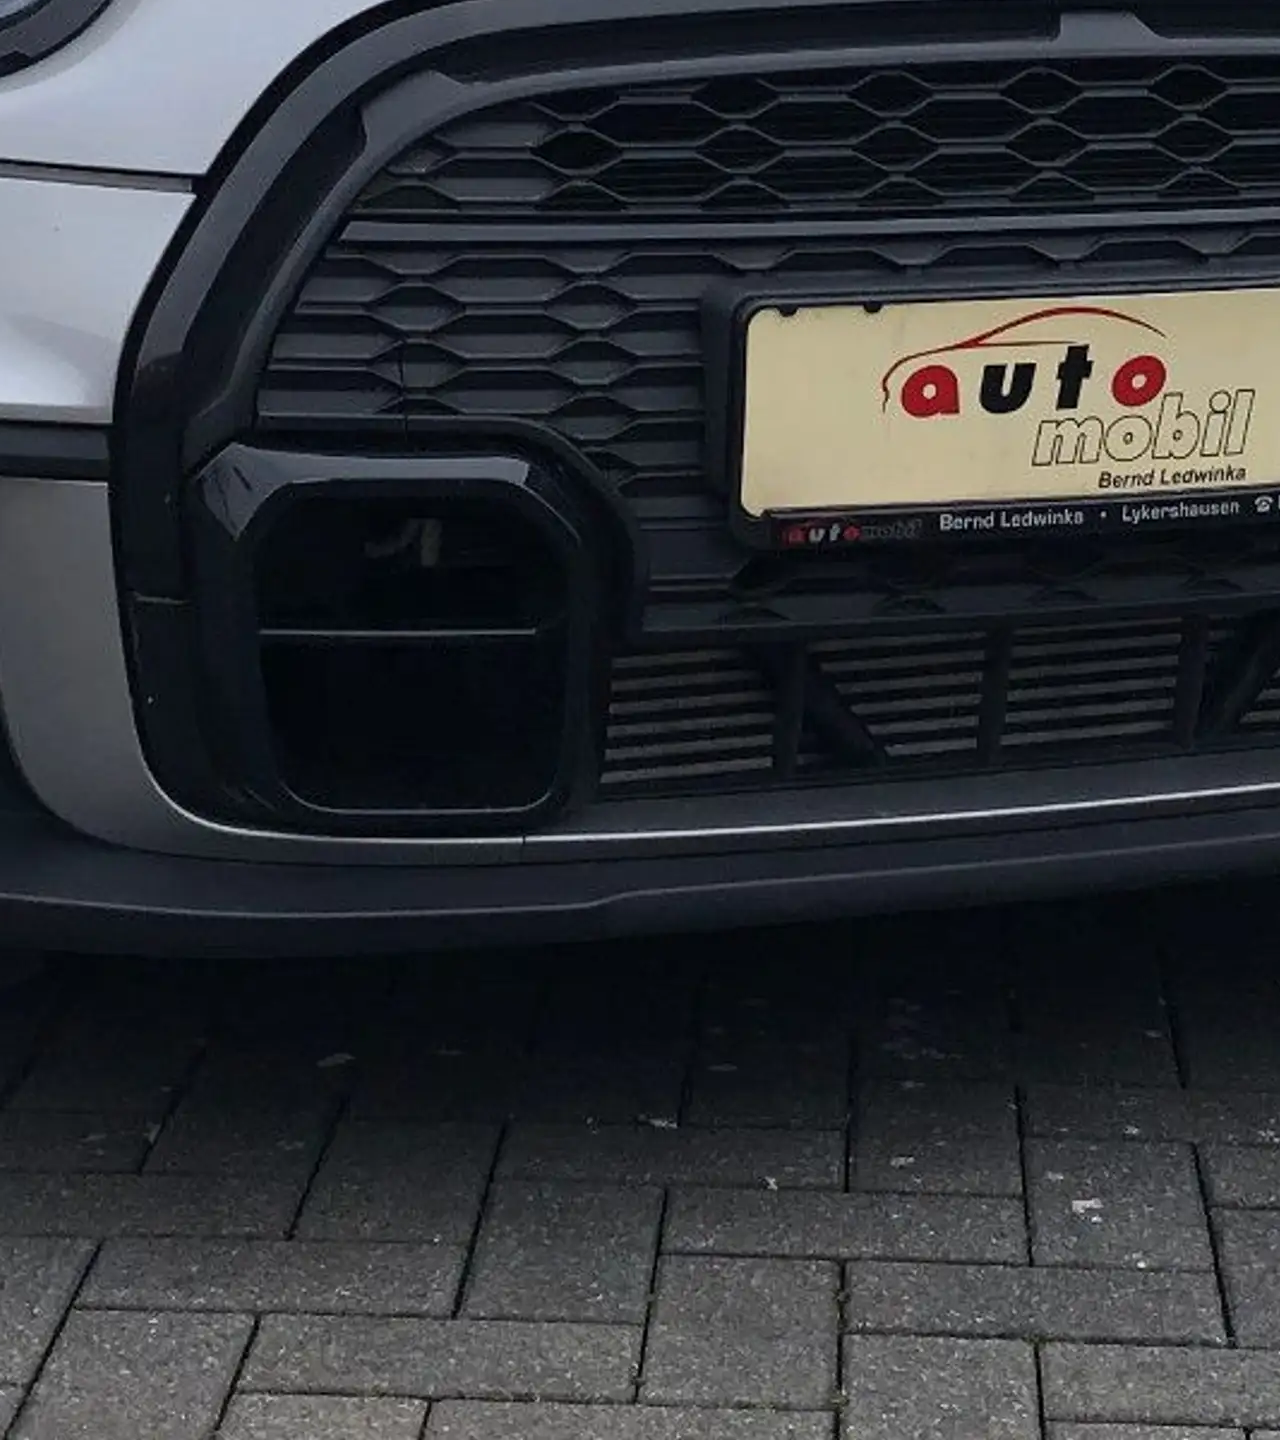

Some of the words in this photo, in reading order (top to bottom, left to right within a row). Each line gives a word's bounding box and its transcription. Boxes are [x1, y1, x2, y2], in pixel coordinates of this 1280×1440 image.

[901, 344, 1167, 418] auto
[1031, 389, 1255, 466] mobil
[1098, 468, 1154, 489] Bernd
[1159, 465, 1247, 486] Ledwinka
[939, 512, 995, 530] Bernd
[1000, 509, 1084, 528] Ledwinka
[1122, 500, 1240, 525] Lykershausen
